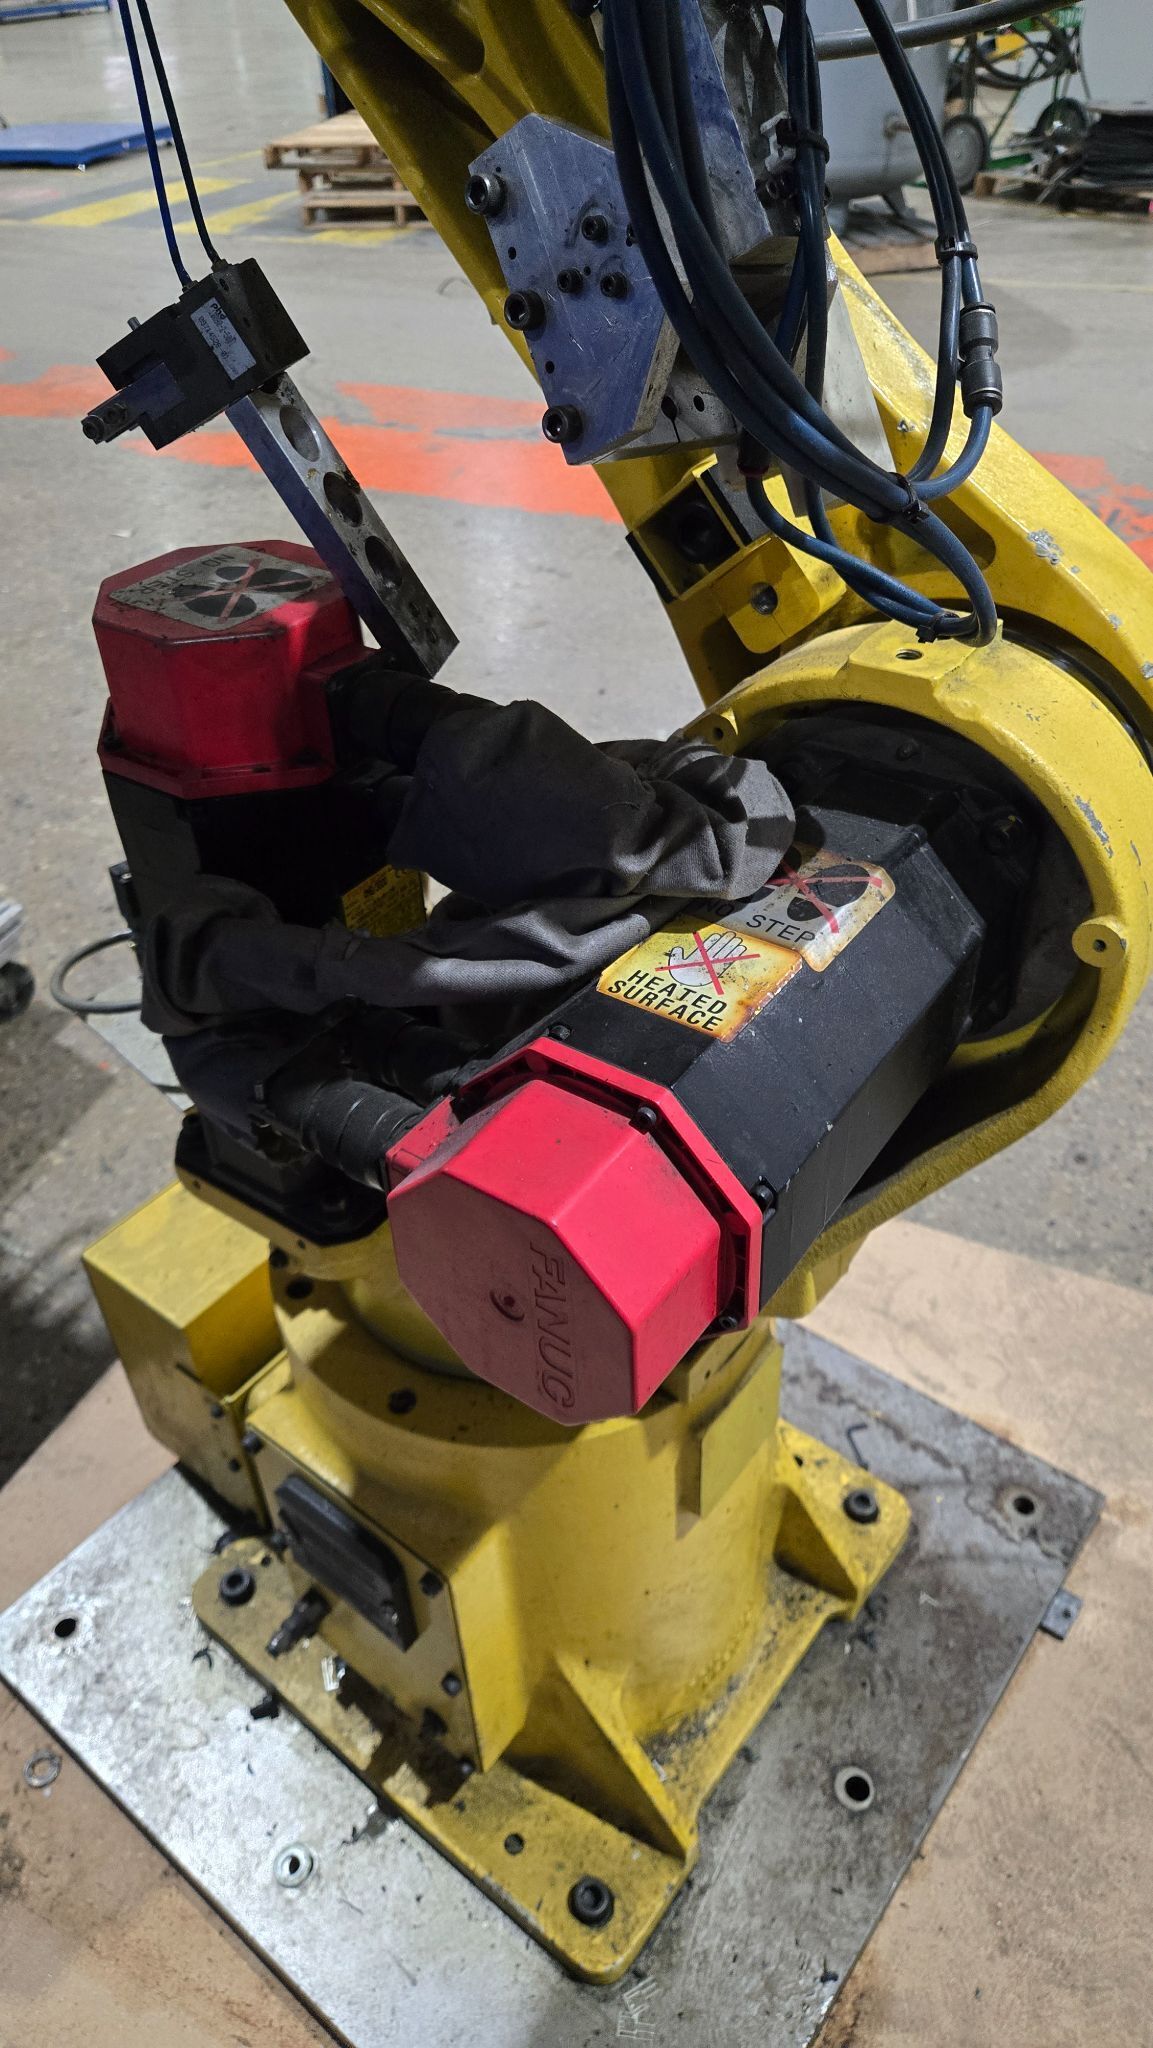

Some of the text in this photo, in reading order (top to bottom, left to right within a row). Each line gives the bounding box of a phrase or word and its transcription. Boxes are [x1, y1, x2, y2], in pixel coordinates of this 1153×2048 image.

[138, 553, 235, 594] NO STEP
[699, 900, 815, 944] NO STEP
[608, 980, 724, 1032] SURFACE
[627, 969, 727, 1015] HEATED
[530, 1241, 575, 1408] FANUC
